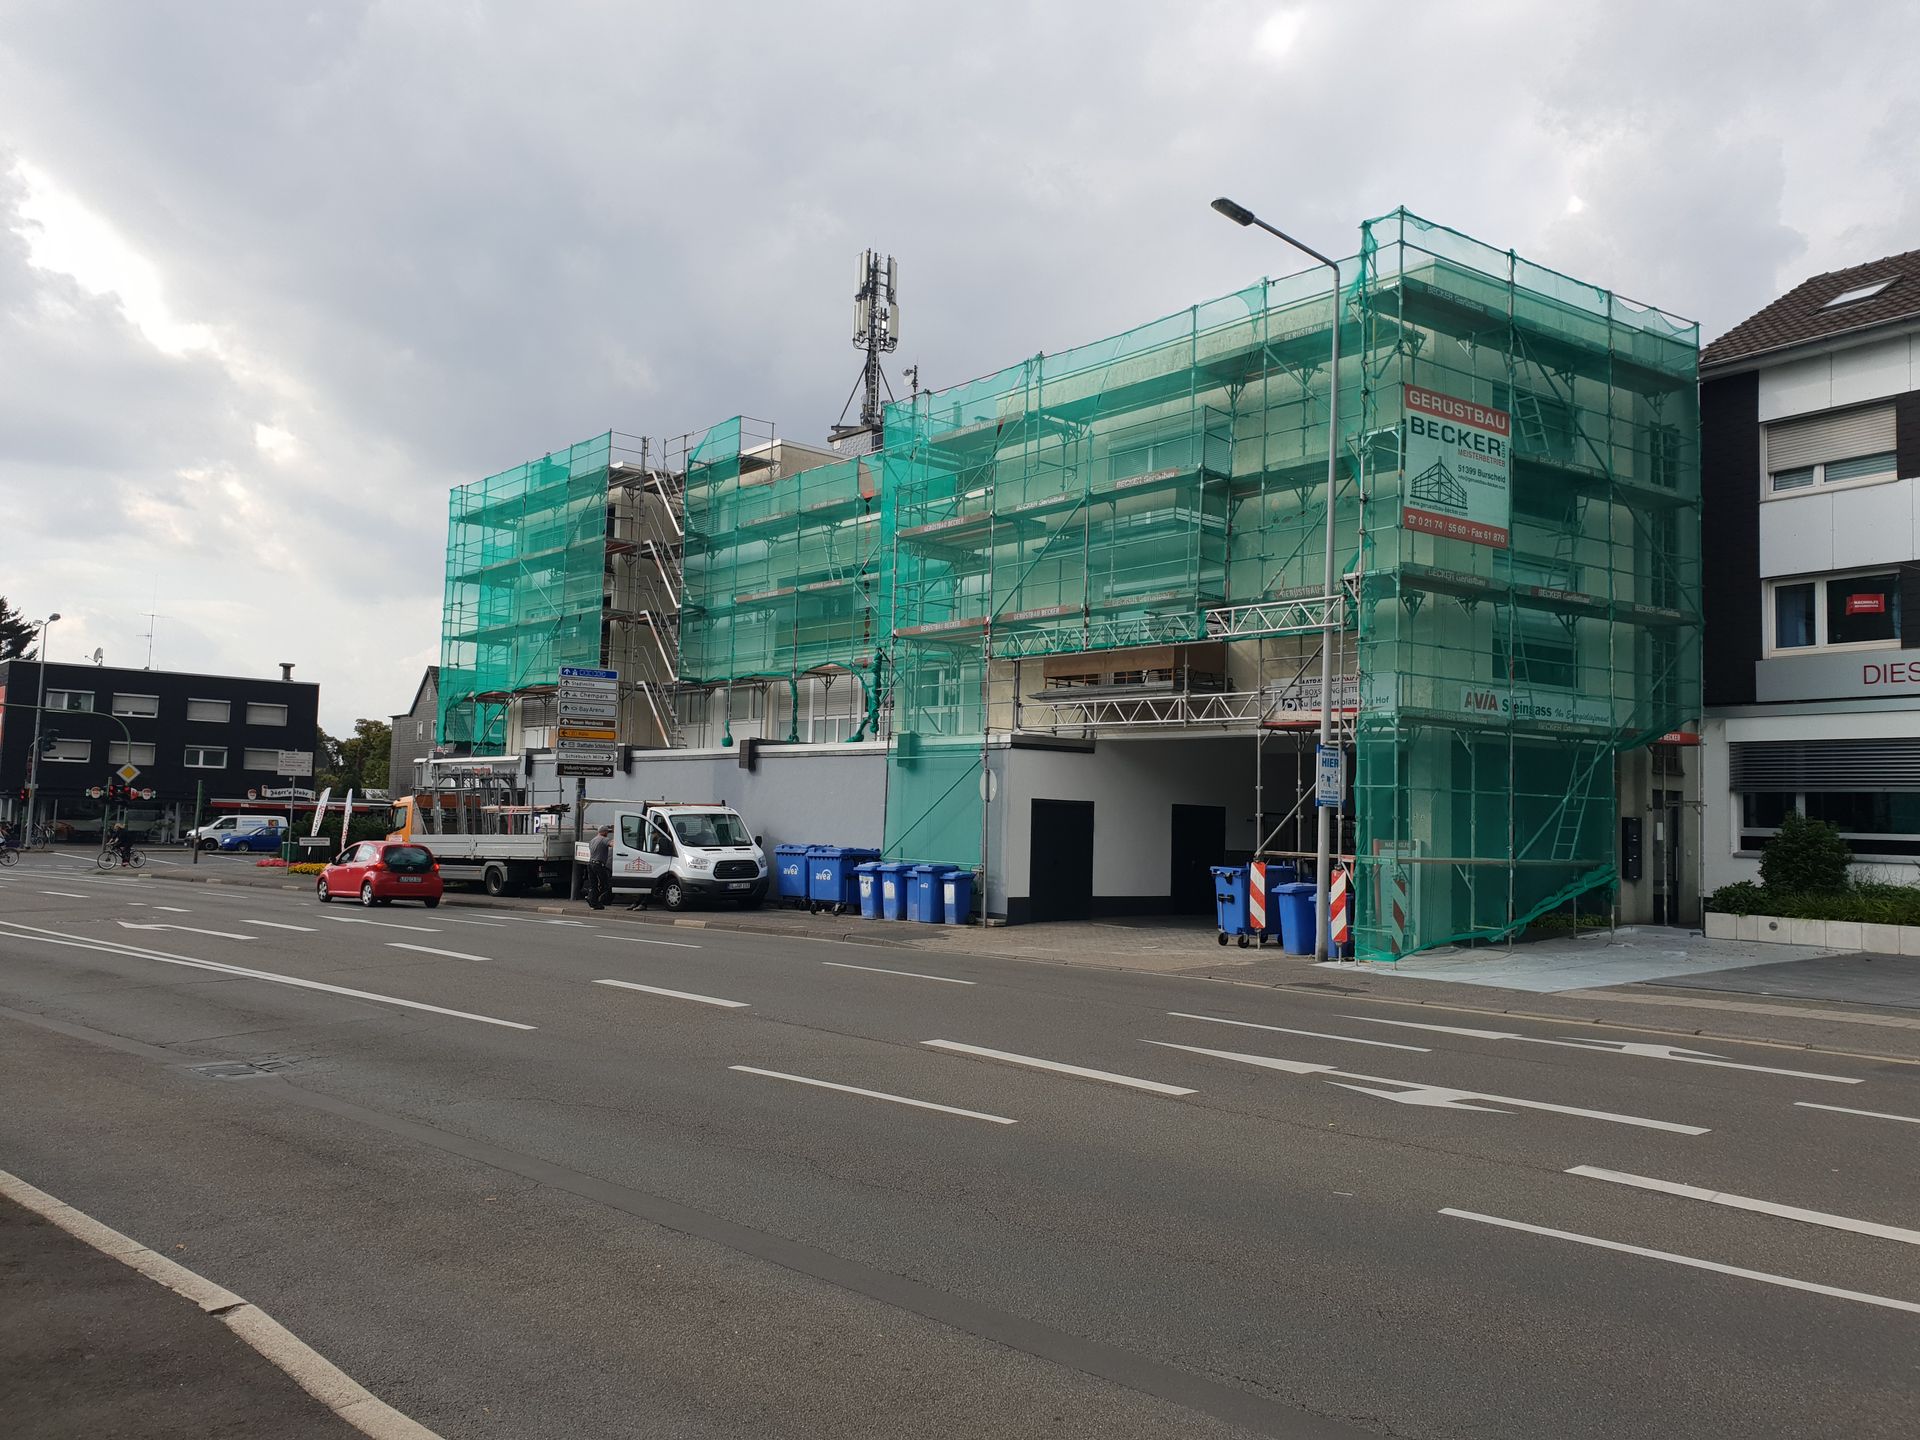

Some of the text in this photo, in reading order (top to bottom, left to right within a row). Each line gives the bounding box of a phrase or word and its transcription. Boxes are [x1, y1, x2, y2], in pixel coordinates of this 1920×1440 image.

[1410, 415, 1501, 458] BECKER
[1457, 448, 1506, 468] MEISTERBETRIEB
[1457, 464, 1506, 484] 51399 Burscheid
[1424, 518, 1432, 528] 21
[1434, 519, 1443, 530] 74
[1457, 524, 1466, 535] 60
[1471, 528, 1484, 539] Fax
[1375, 696, 1389, 704] Hof
[1321, 757, 1339, 768] HIER
